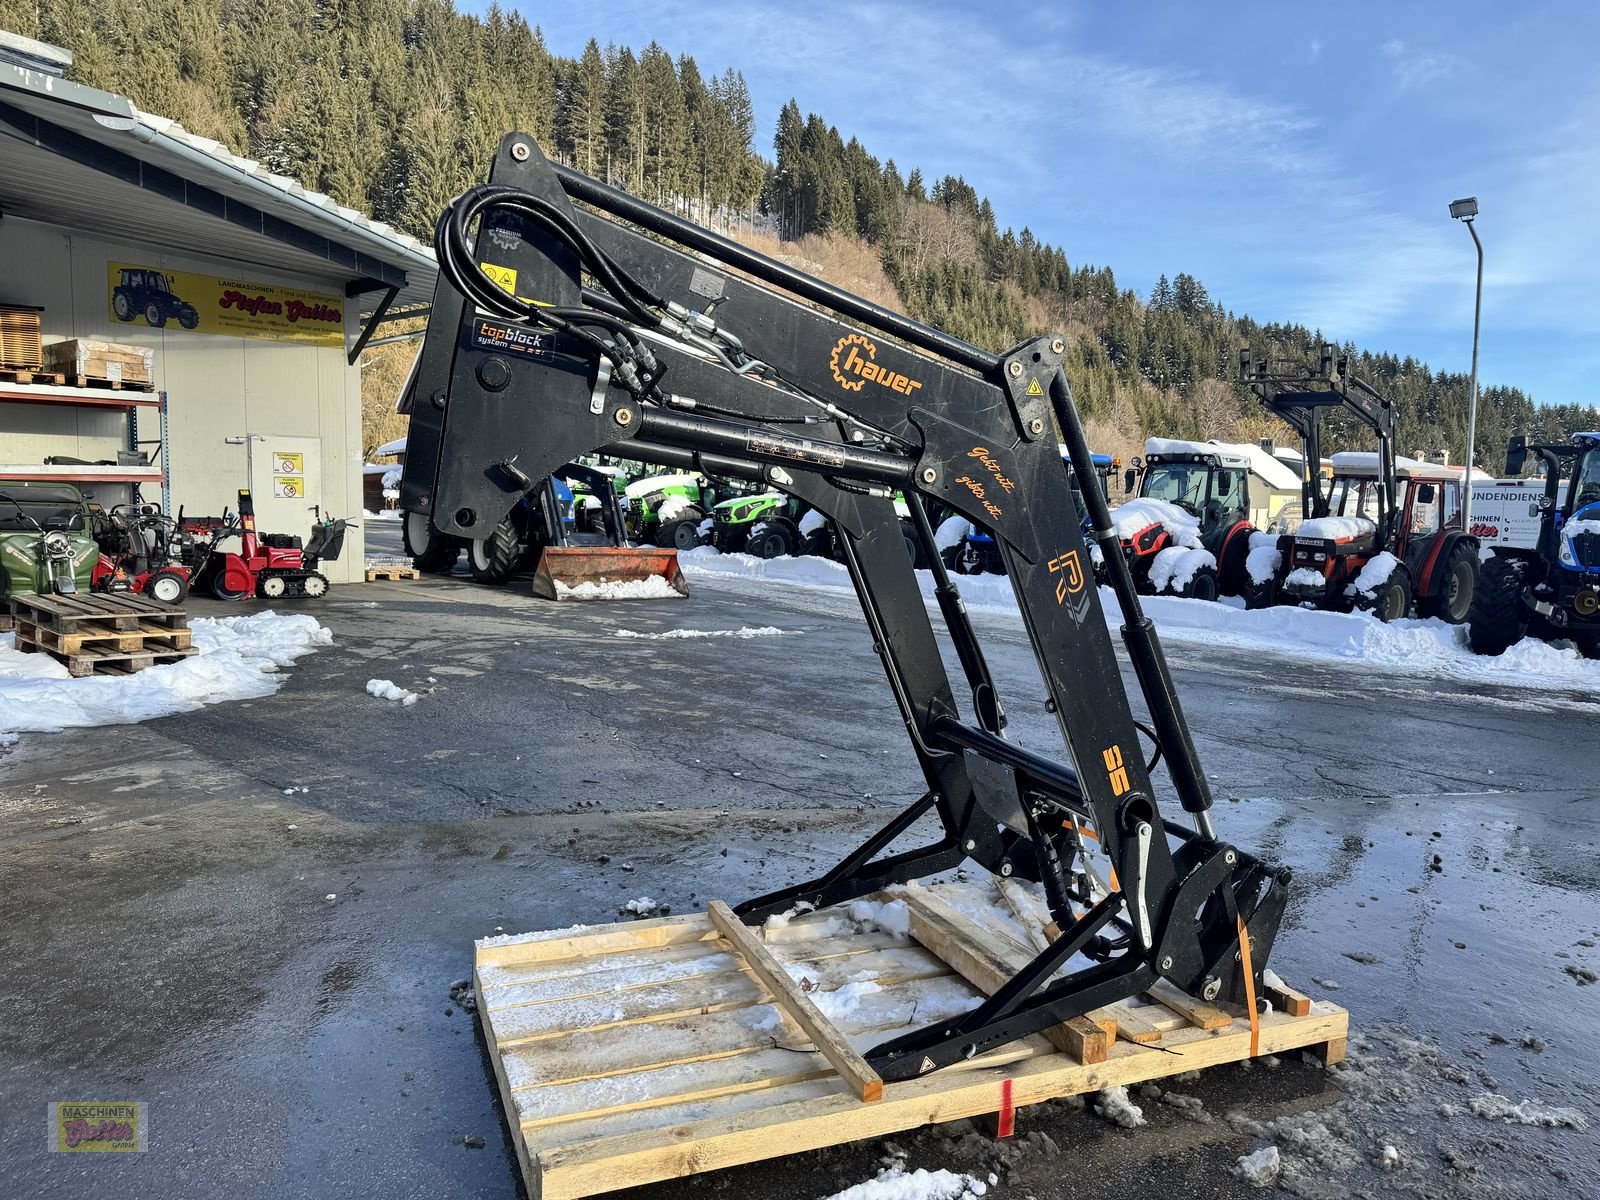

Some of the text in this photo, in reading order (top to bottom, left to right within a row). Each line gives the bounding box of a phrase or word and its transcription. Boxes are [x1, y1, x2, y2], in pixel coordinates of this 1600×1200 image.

[218, 280, 275, 295] LANDMASCHINEN
[295, 291, 306, 299] und
[218, 290, 283, 316] Stefan
[477, 336, 508, 348] system
[480, 323, 543, 347] topblock
[843, 346, 923, 396] hauer
[1461, 491, 1545, 502] UNDENDIENS
[1470, 515, 1500, 523] CHINEN
